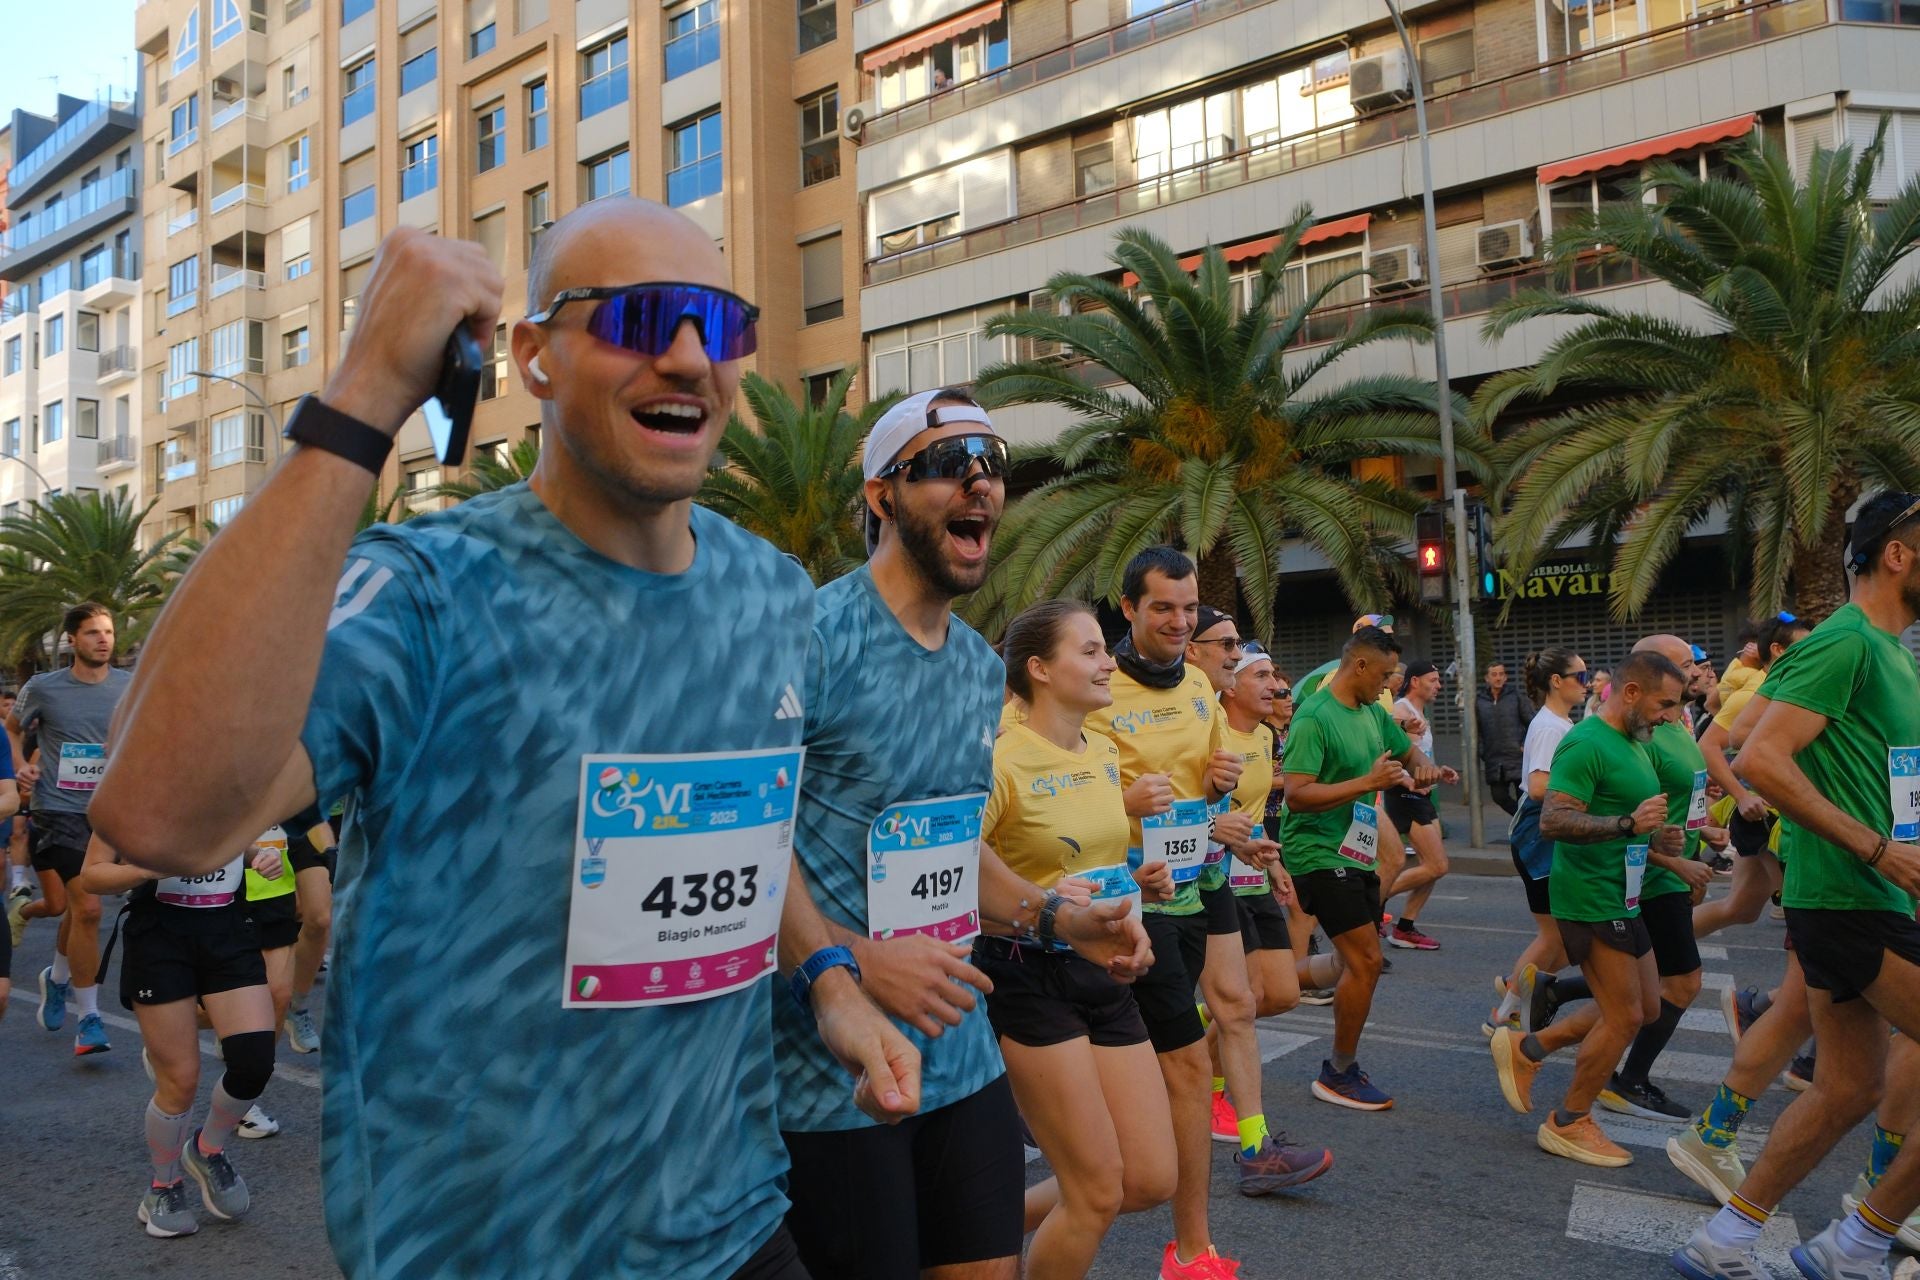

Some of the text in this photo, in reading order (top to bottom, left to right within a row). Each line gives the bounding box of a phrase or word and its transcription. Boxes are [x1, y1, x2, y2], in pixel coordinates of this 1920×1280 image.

[655, 782, 692, 814] VI
[1164, 838, 1197, 856] 1363
[641, 864, 758, 919] 4383
[911, 866, 964, 900] 4197
[931, 902, 949, 912] Mattia
[657, 917, 747, 943] Biagio Mancusi
